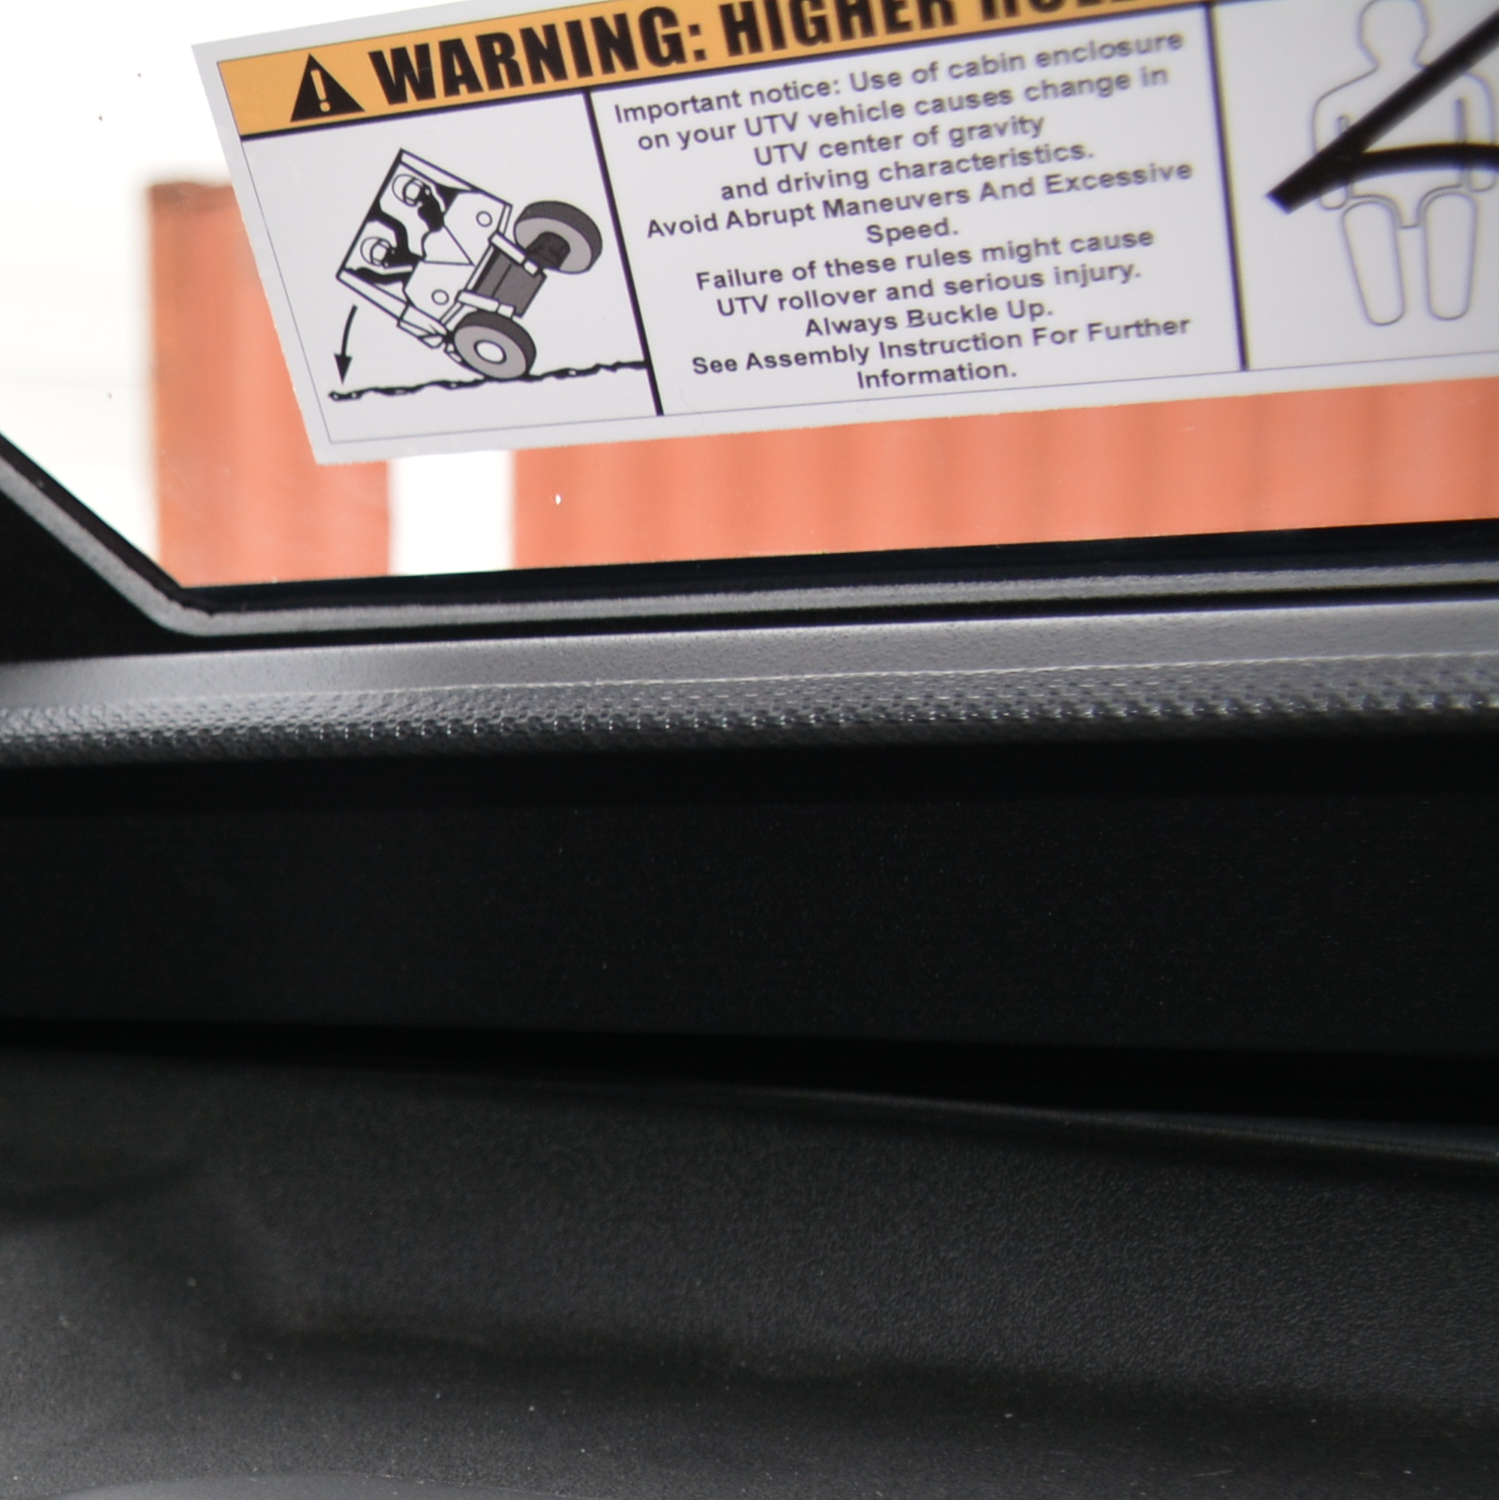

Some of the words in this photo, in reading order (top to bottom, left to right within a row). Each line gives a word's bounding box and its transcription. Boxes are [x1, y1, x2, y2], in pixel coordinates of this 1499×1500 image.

[368, 6, 707, 106] WARNING:
[614, 89, 742, 124] Important
[750, 79, 841, 106] notice:
[849, 67, 903, 92] Use
[911, 61, 939, 84] of
[948, 52, 1026, 80] cabin
[1035, 32, 1184, 68] enclosure
[638, 132, 670, 151] on
[677, 123, 736, 151] your
[745, 112, 799, 137] UTV
[808, 100, 906, 129] vehicle
[914, 88, 1014, 116] causes
[1024, 72, 1131, 103] change
[1141, 66, 1170, 87] in
[754, 141, 808, 166] UTV
[818, 132, 904, 159] center
[912, 125, 940, 147] of
[949, 115, 1045, 148] gravity
[647, 212, 719, 238] Avoid
[726, 203, 816, 230] Abrupt
[822, 187, 971, 219] Maneuvers
[979, 177, 1036, 202] And
[1044, 162, 1194, 196] Excessive
[721, 177, 768, 201] and
[777, 164, 870, 190] driving
[878, 142, 1095, 183] characteristics.
[696, 267, 784, 291] Failure
[792, 260, 817, 281] of
[824, 256, 897, 278] these
[905, 248, 972, 270] rules
[981, 236, 1063, 264] might
[1069, 229, 1155, 254] cause
[866, 216, 959, 247] Speed.
[717, 294, 769, 317] UTV
[778, 286, 878, 312] rollover
[885, 278, 934, 301] and
[943, 271, 1045, 297] serious
[1053, 263, 1142, 289] injury.
[805, 314, 899, 338] Always
[906, 303, 999, 329] Buckle
[1007, 298, 1053, 322] Up.
[692, 357, 738, 376] See
[746, 342, 870, 371] Assembly
[879, 330, 1023, 360] Instruction
[1032, 326, 1079, 347] For
[1087, 317, 1191, 343] Further
[857, 361, 1017, 388] Information.
